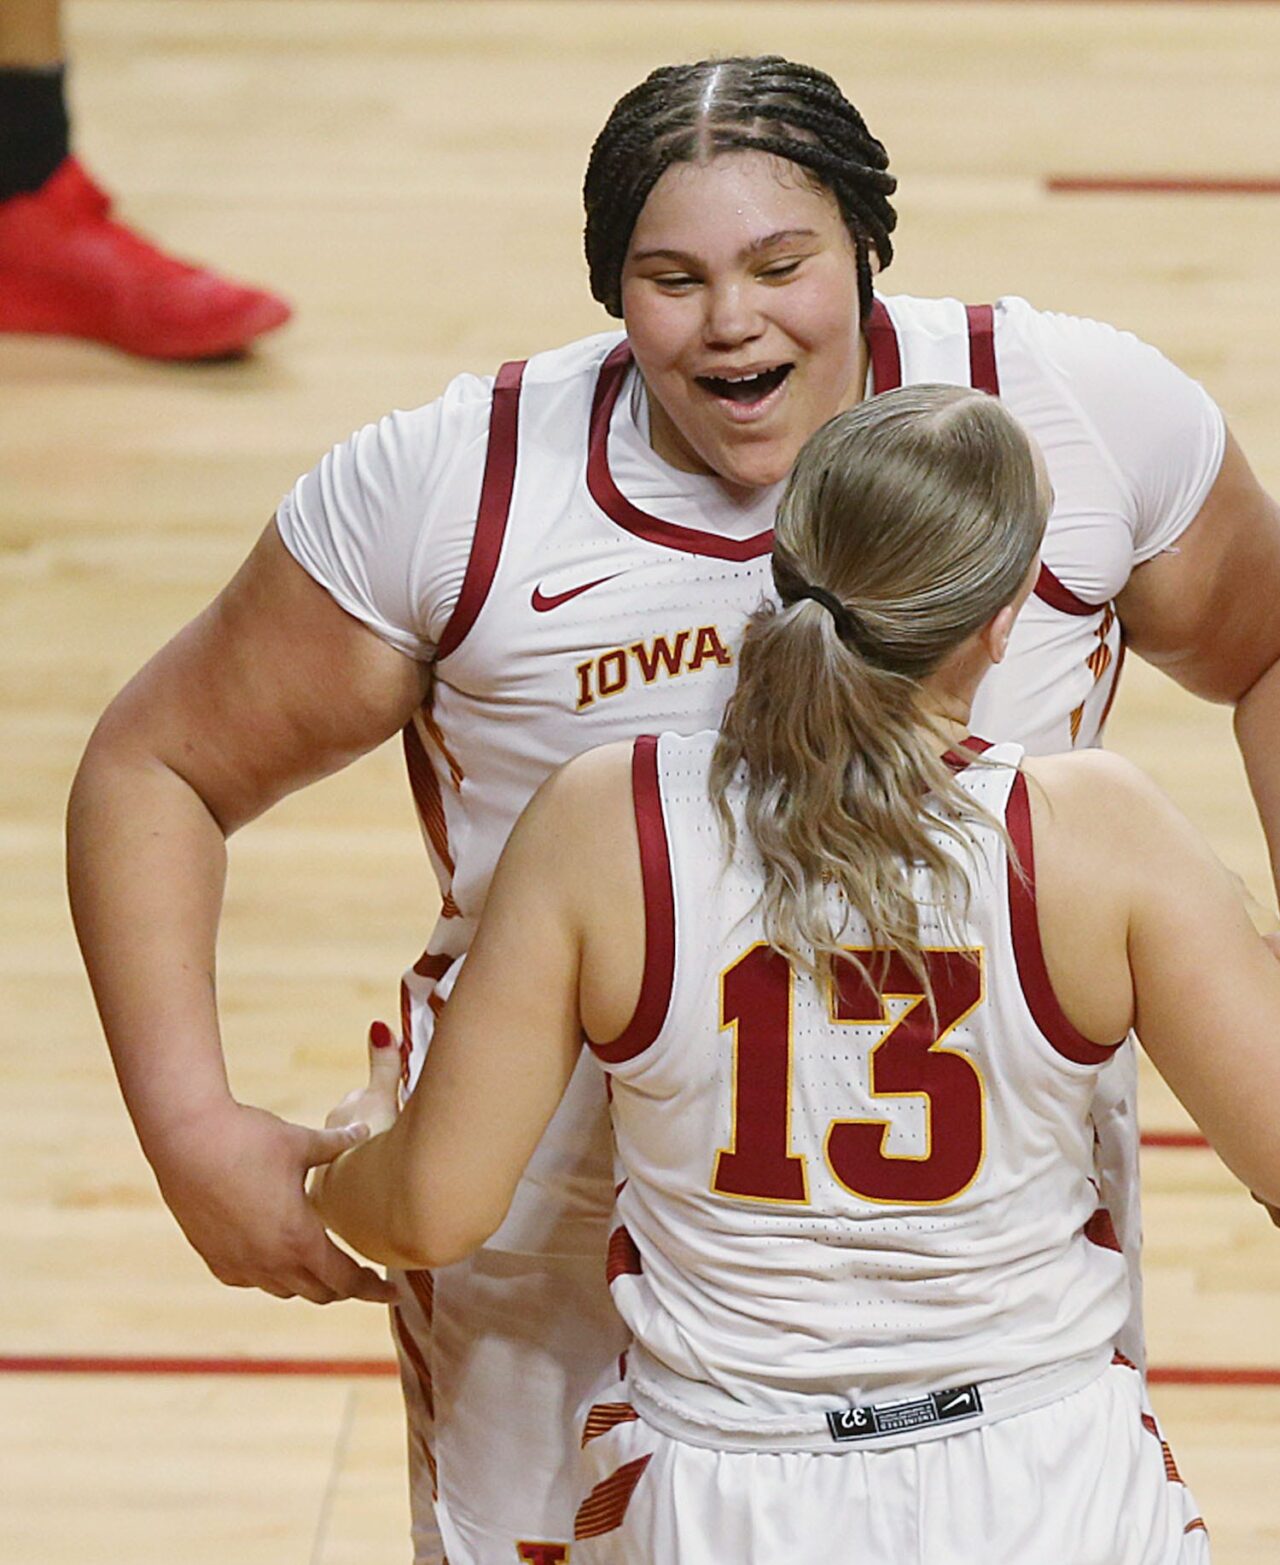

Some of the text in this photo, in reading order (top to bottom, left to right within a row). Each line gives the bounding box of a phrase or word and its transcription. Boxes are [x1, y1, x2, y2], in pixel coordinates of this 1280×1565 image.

[576, 624, 732, 711] IOWA
[709, 940, 987, 1206] 13
[841, 1407, 868, 1429] 32
